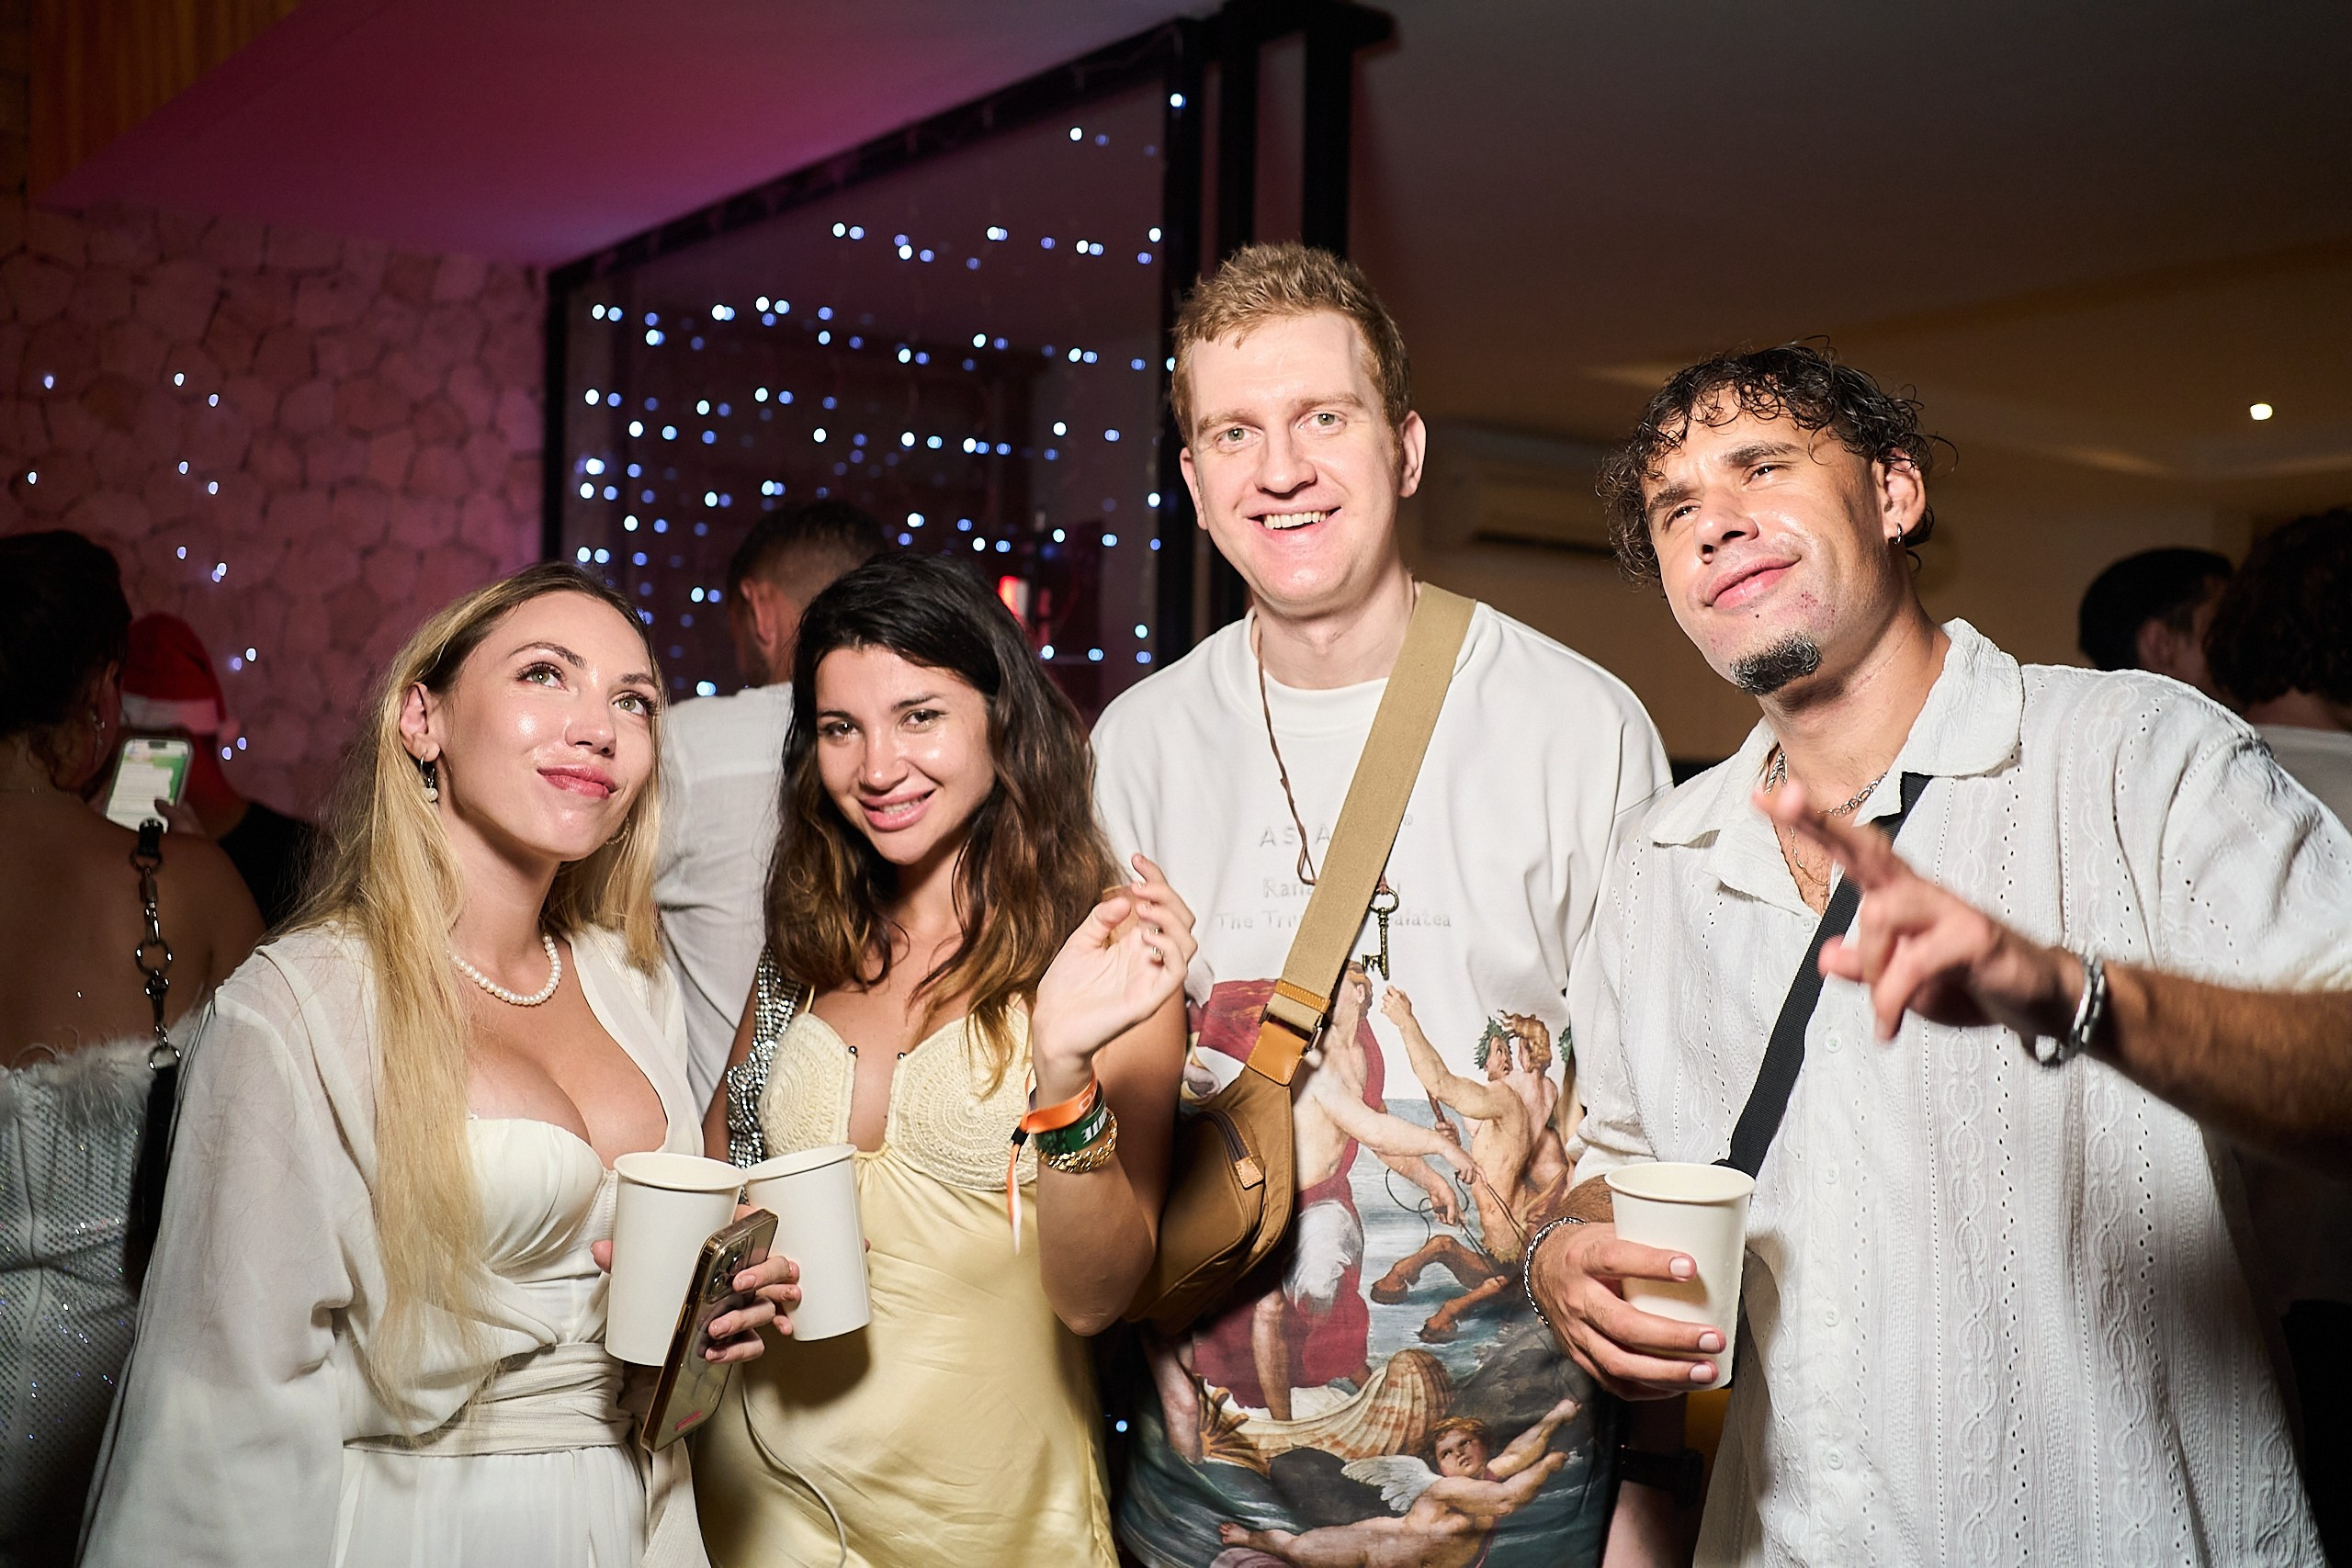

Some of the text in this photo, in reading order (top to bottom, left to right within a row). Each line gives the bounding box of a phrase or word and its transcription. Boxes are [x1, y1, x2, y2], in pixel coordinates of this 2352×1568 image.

[1216, 908, 1452, 930] The Tri alatea
